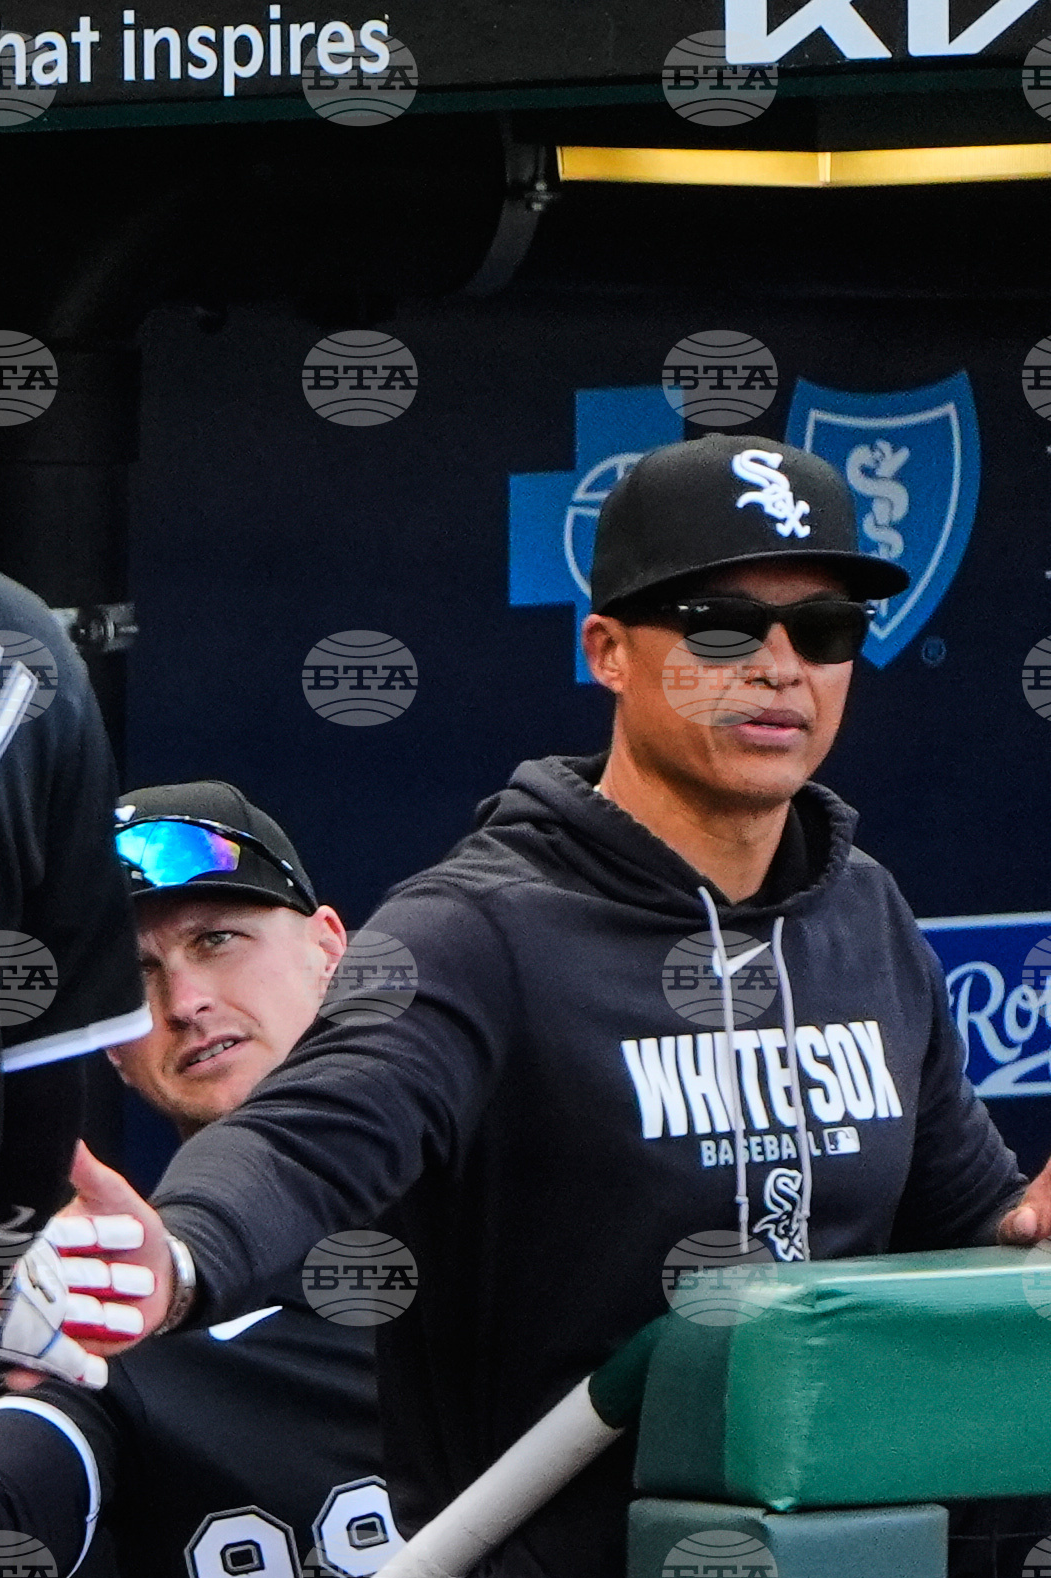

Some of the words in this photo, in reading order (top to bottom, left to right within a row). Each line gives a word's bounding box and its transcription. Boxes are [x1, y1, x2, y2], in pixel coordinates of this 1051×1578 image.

[122, 4, 390, 97] inspires
[946, 961, 1051, 1064] Ro
[621, 1028, 798, 1139] WHITE
[795, 1020, 903, 1123] SOX
[701, 1131, 822, 1168] BAEBAL
